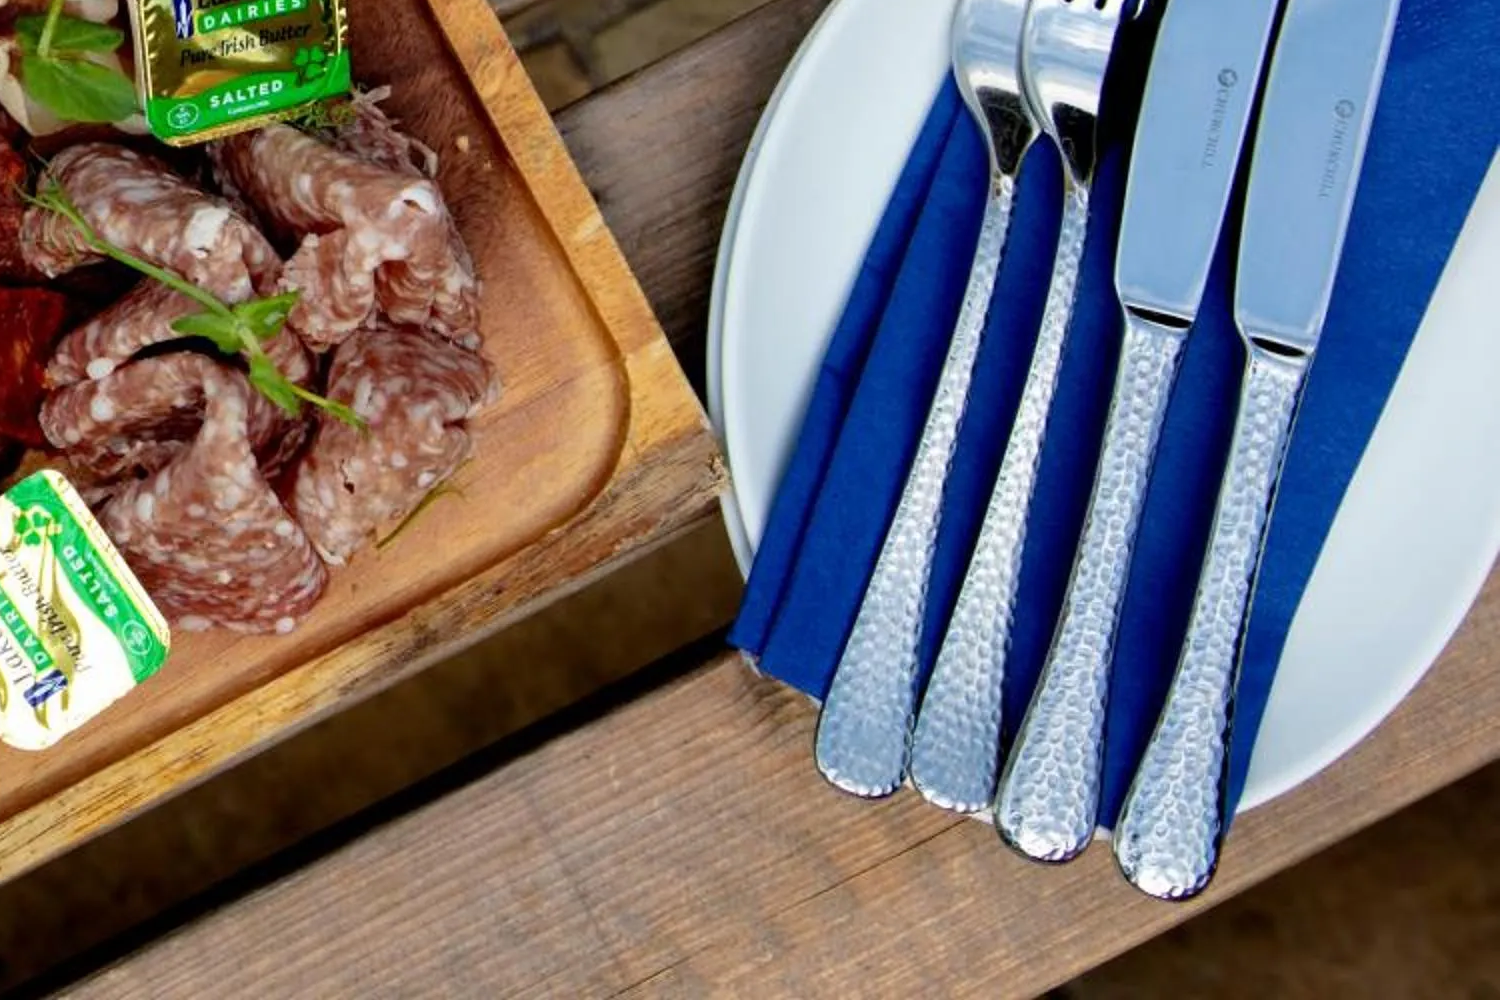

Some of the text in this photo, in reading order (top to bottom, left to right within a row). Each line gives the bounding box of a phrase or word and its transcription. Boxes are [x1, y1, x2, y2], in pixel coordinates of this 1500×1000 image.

[220, 33, 256, 58] Irish
[259, 23, 312, 47] Butter
[209, 80, 283, 108] SALTED
[59, 541, 119, 619] SALTED
